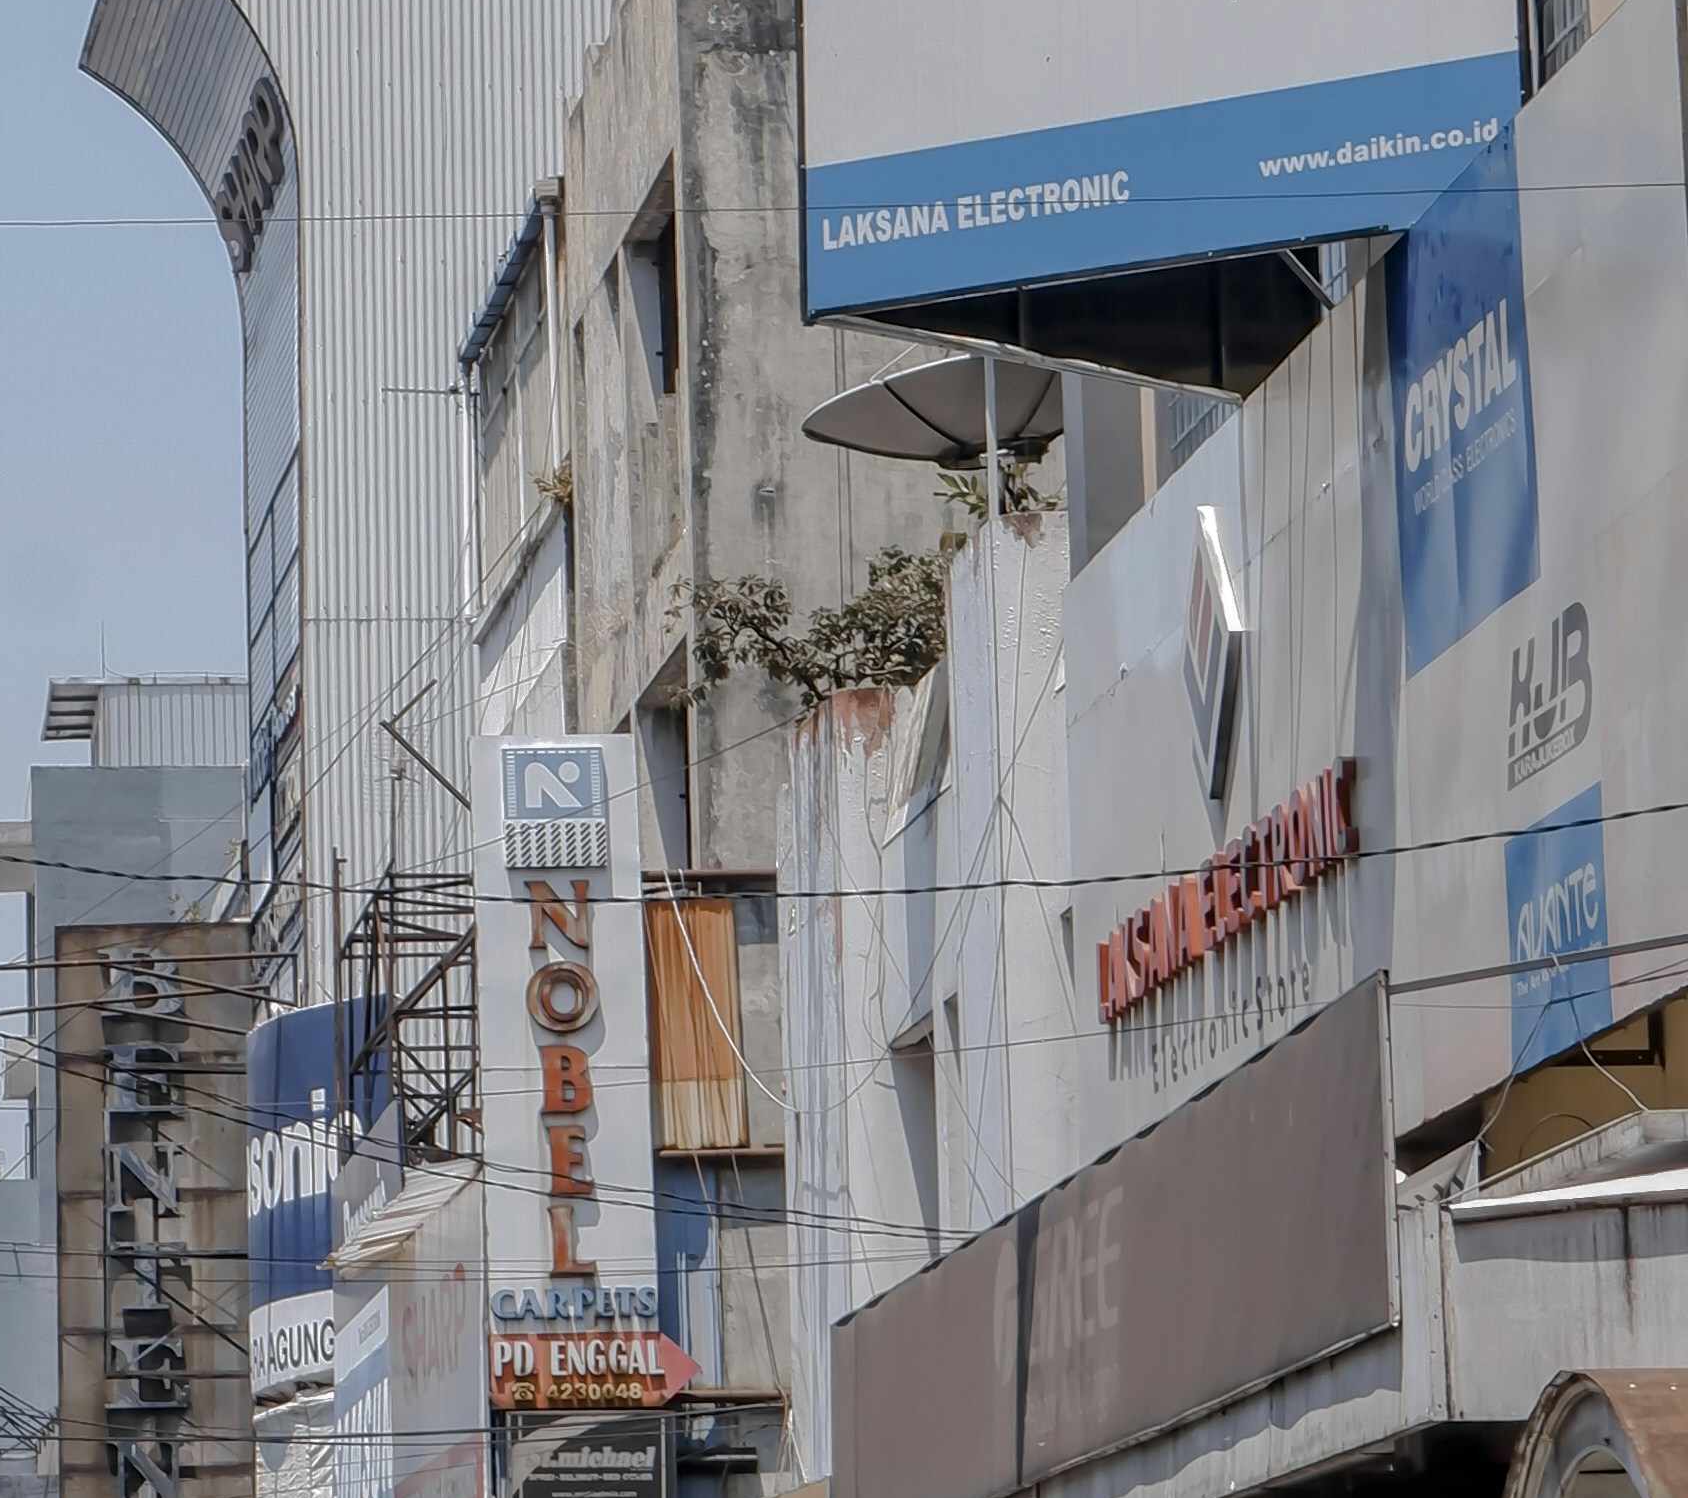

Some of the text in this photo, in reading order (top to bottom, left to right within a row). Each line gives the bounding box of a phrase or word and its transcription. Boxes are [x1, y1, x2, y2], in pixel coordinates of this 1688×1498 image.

[1258, 117, 1500, 178] www.daikin.co.id
[821, 169, 1131, 252] LAKSANA ELECTRONIC
[1405, 298, 1517, 475] CRYSTAL
[1513, 723, 1577, 785] KARAJUKEBOX
[1517, 862, 1600, 965] AVANTE
[1254, 960, 1310, 1033] Store
[526, 878, 596, 1278] NOBEL
[490, 1287, 659, 1321] CARPETS
[269, 1316, 335, 1373] AGUNG
[550, 1338, 665, 1377] ENGGAL
[547, 1381, 643, 1401] 4230048
